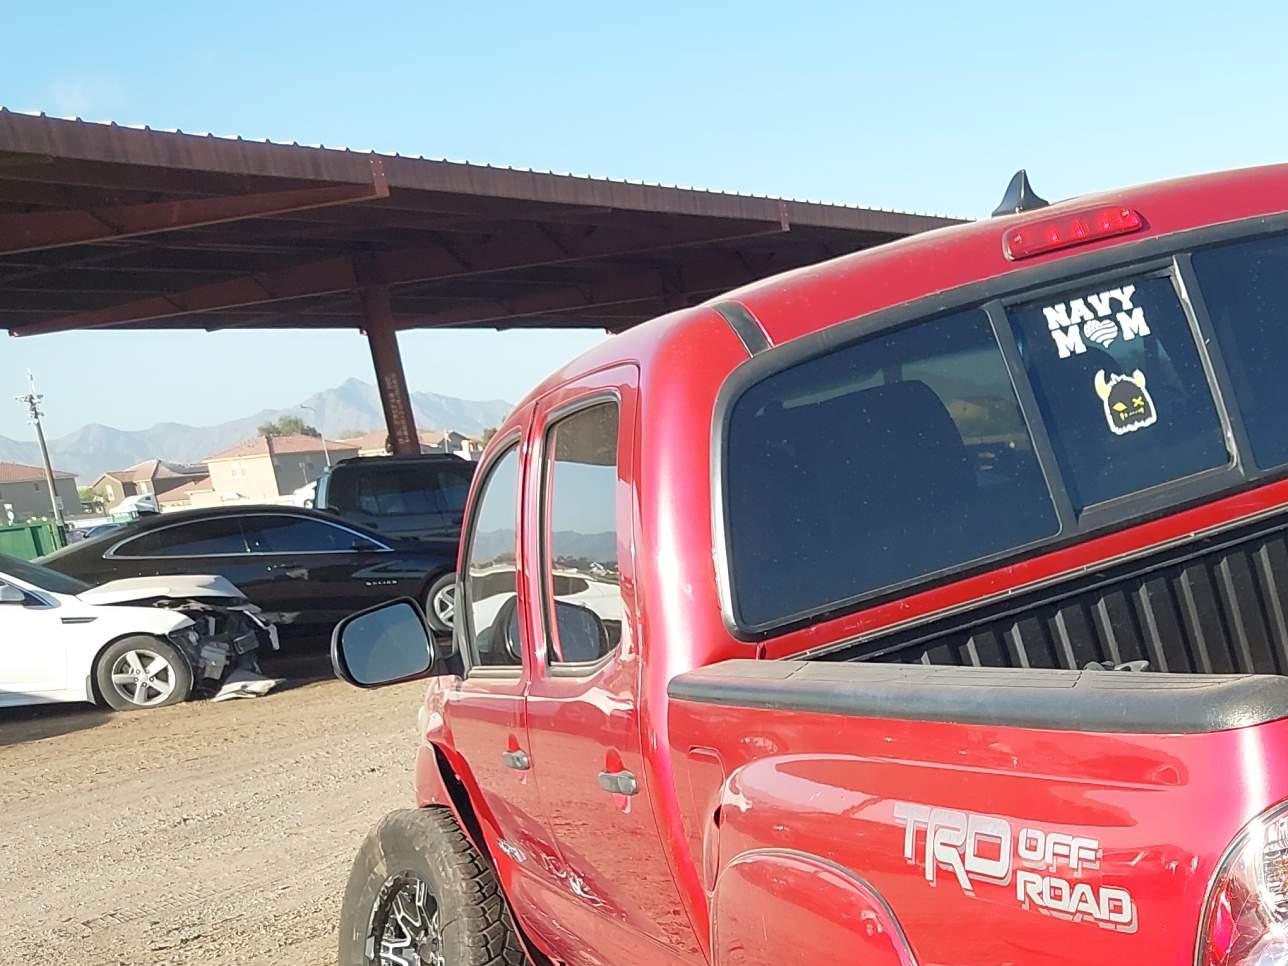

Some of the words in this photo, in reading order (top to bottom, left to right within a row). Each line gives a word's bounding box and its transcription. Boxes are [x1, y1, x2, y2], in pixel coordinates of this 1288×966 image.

[1042, 284, 1136, 331] NAVY
[893, 800, 1013, 897] TRD
[1017, 828, 1103, 878] OFF
[1016, 870, 1139, 934] ROAD
